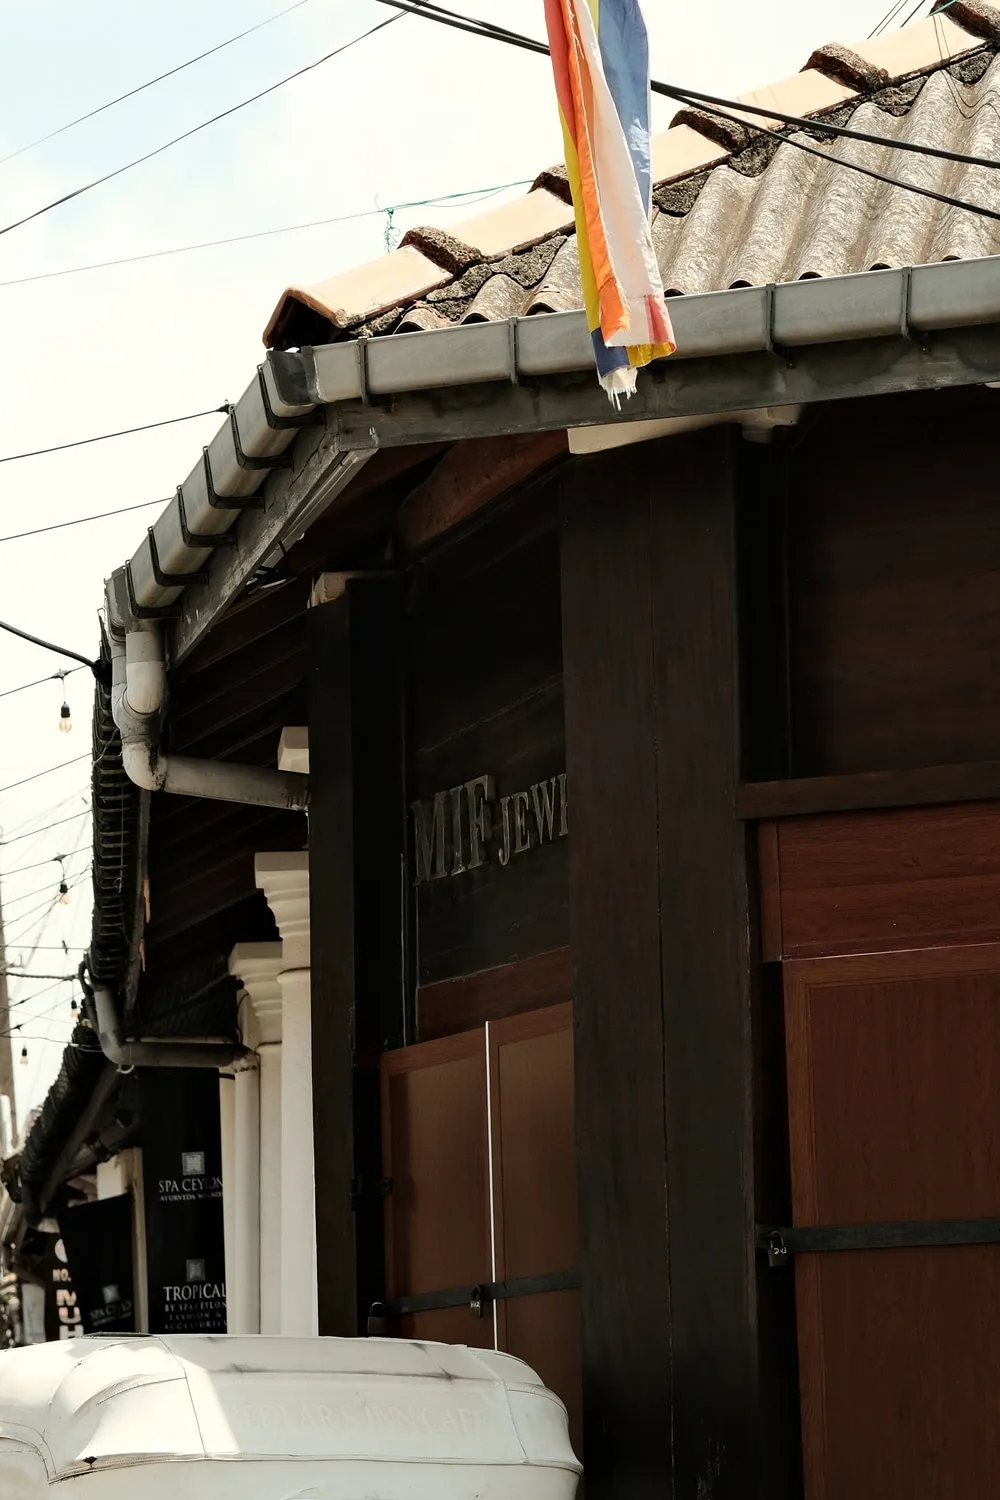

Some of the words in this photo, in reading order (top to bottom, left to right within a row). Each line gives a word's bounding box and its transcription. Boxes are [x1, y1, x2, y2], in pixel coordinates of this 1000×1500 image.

[410, 774, 490, 886] MIF
[158, 1179, 180, 1193] SPA
[163, 1283, 226, 1302] TROPICAL
[164, 1303, 175, 1313] BY
